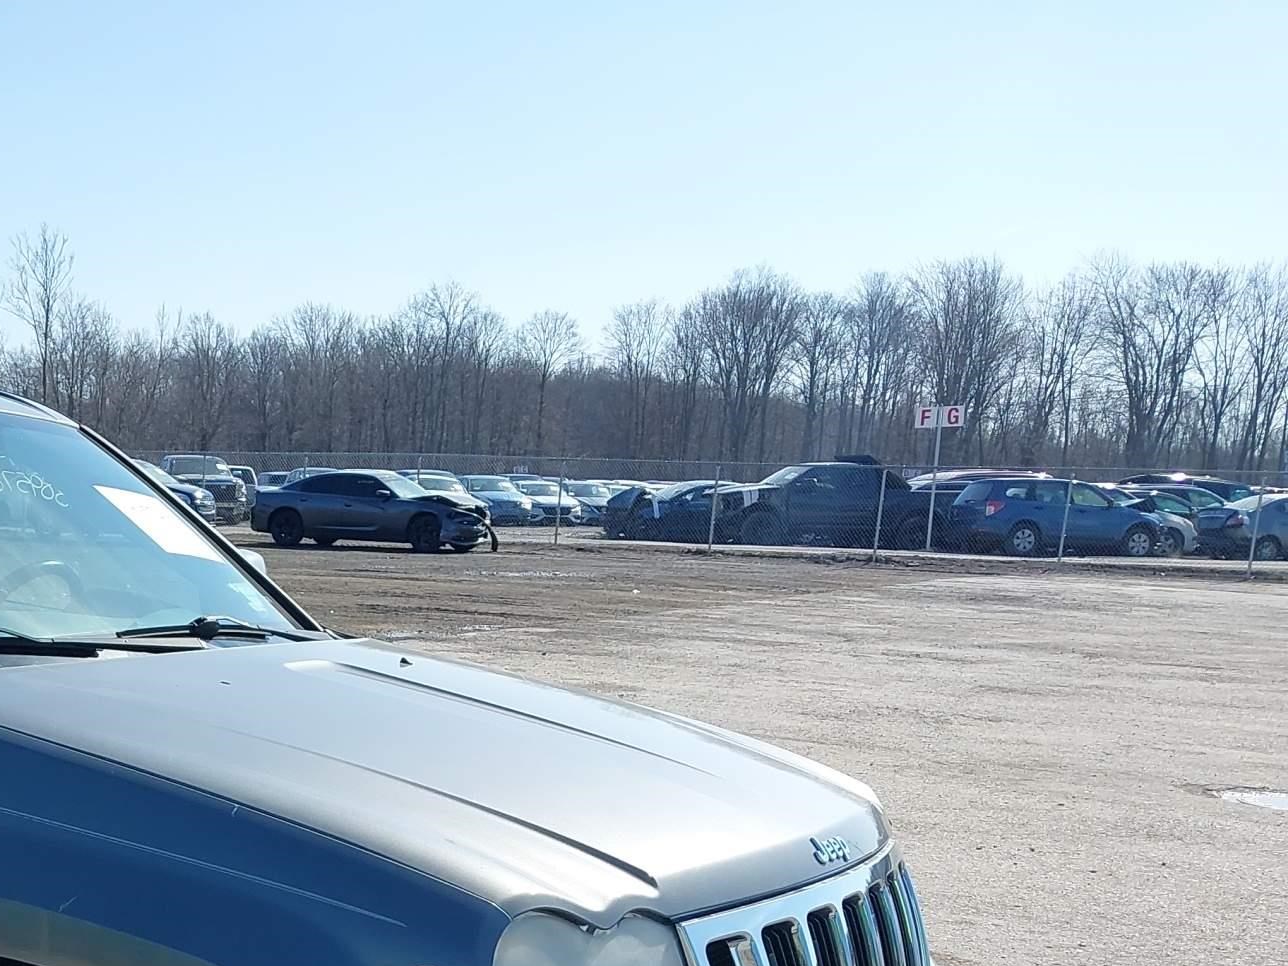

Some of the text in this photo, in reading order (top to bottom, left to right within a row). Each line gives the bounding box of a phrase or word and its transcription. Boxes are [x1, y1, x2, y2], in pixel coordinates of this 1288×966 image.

[920, 409, 932, 426] F
[947, 407, 960, 425] G
[809, 837, 849, 866] Jeep
